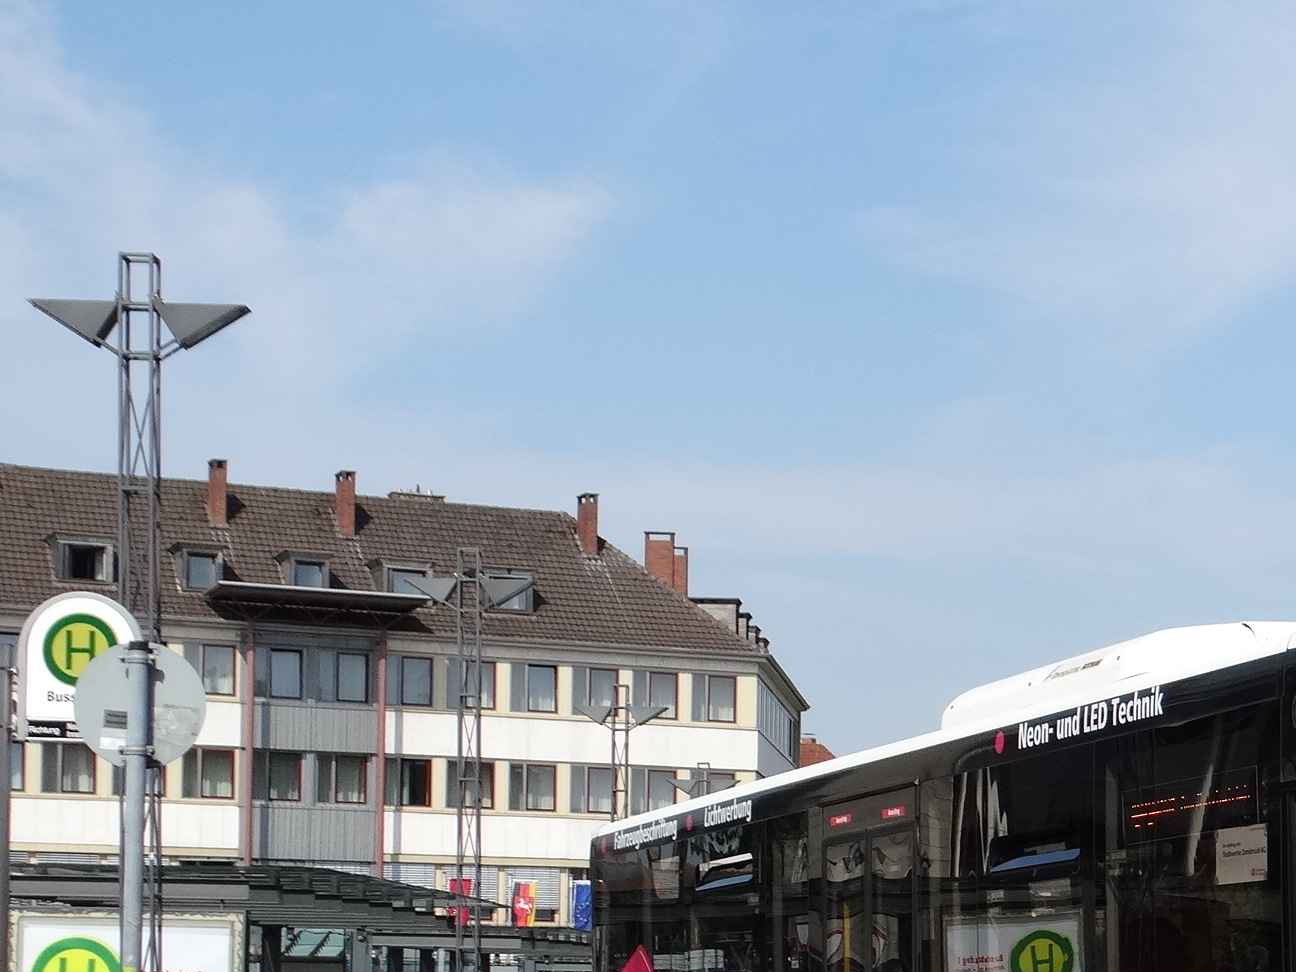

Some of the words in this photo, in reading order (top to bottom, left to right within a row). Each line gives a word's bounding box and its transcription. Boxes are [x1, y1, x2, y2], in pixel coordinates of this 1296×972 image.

[66, 630, 95, 669] H
[28, 725, 61, 736] Richtung
[1017, 722, 1054, 749] Neon-
[1056, 706, 1080, 740] und
[1083, 701, 1108, 733] LED
[1111, 685, 1164, 726] Technik
[704, 798, 752, 828] Lichtwerbung
